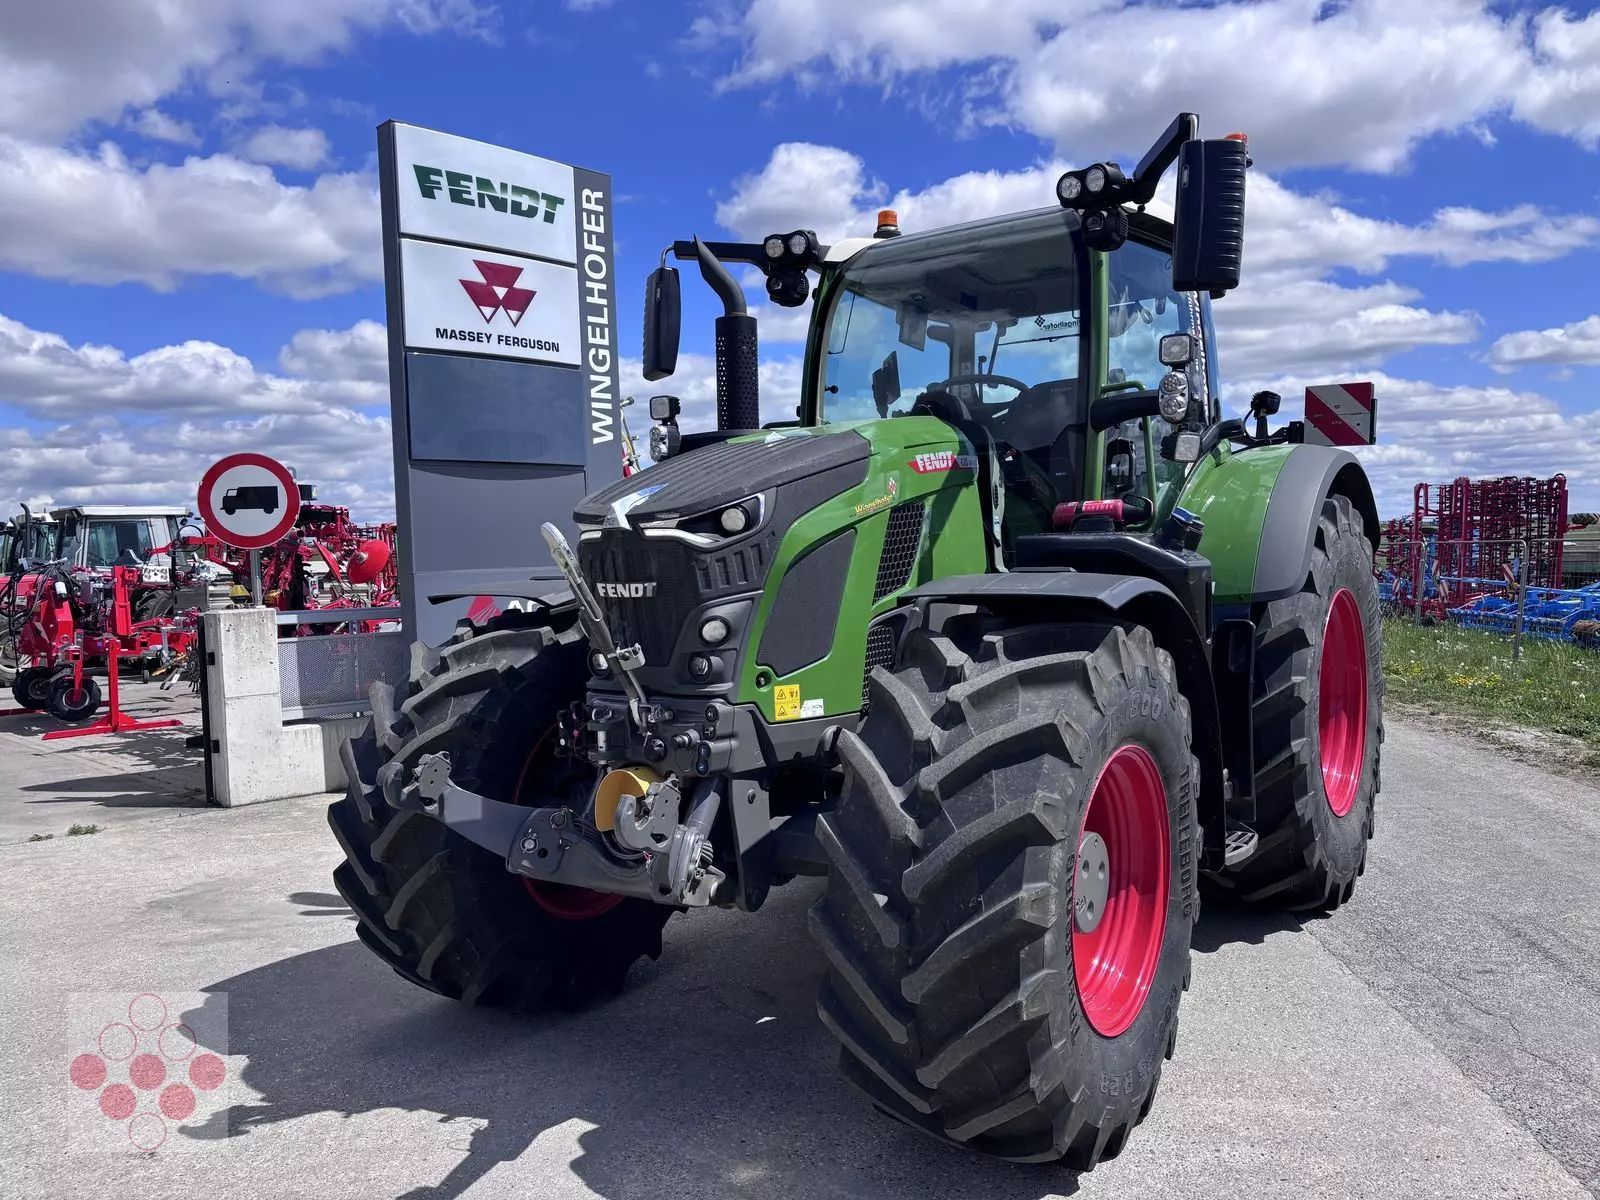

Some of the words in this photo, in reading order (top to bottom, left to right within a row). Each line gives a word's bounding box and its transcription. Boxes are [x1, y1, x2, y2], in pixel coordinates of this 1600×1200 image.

[413, 164, 565, 224] FENDT
[582, 188, 614, 445] WINGELHOFER
[435, 328, 493, 344] MASSEY
[497, 334, 560, 353] FERGUSON
[915, 451, 953, 472] FENDT
[596, 582, 657, 598] FENDT
[1178, 764, 1193, 920] TRELLEBORG
